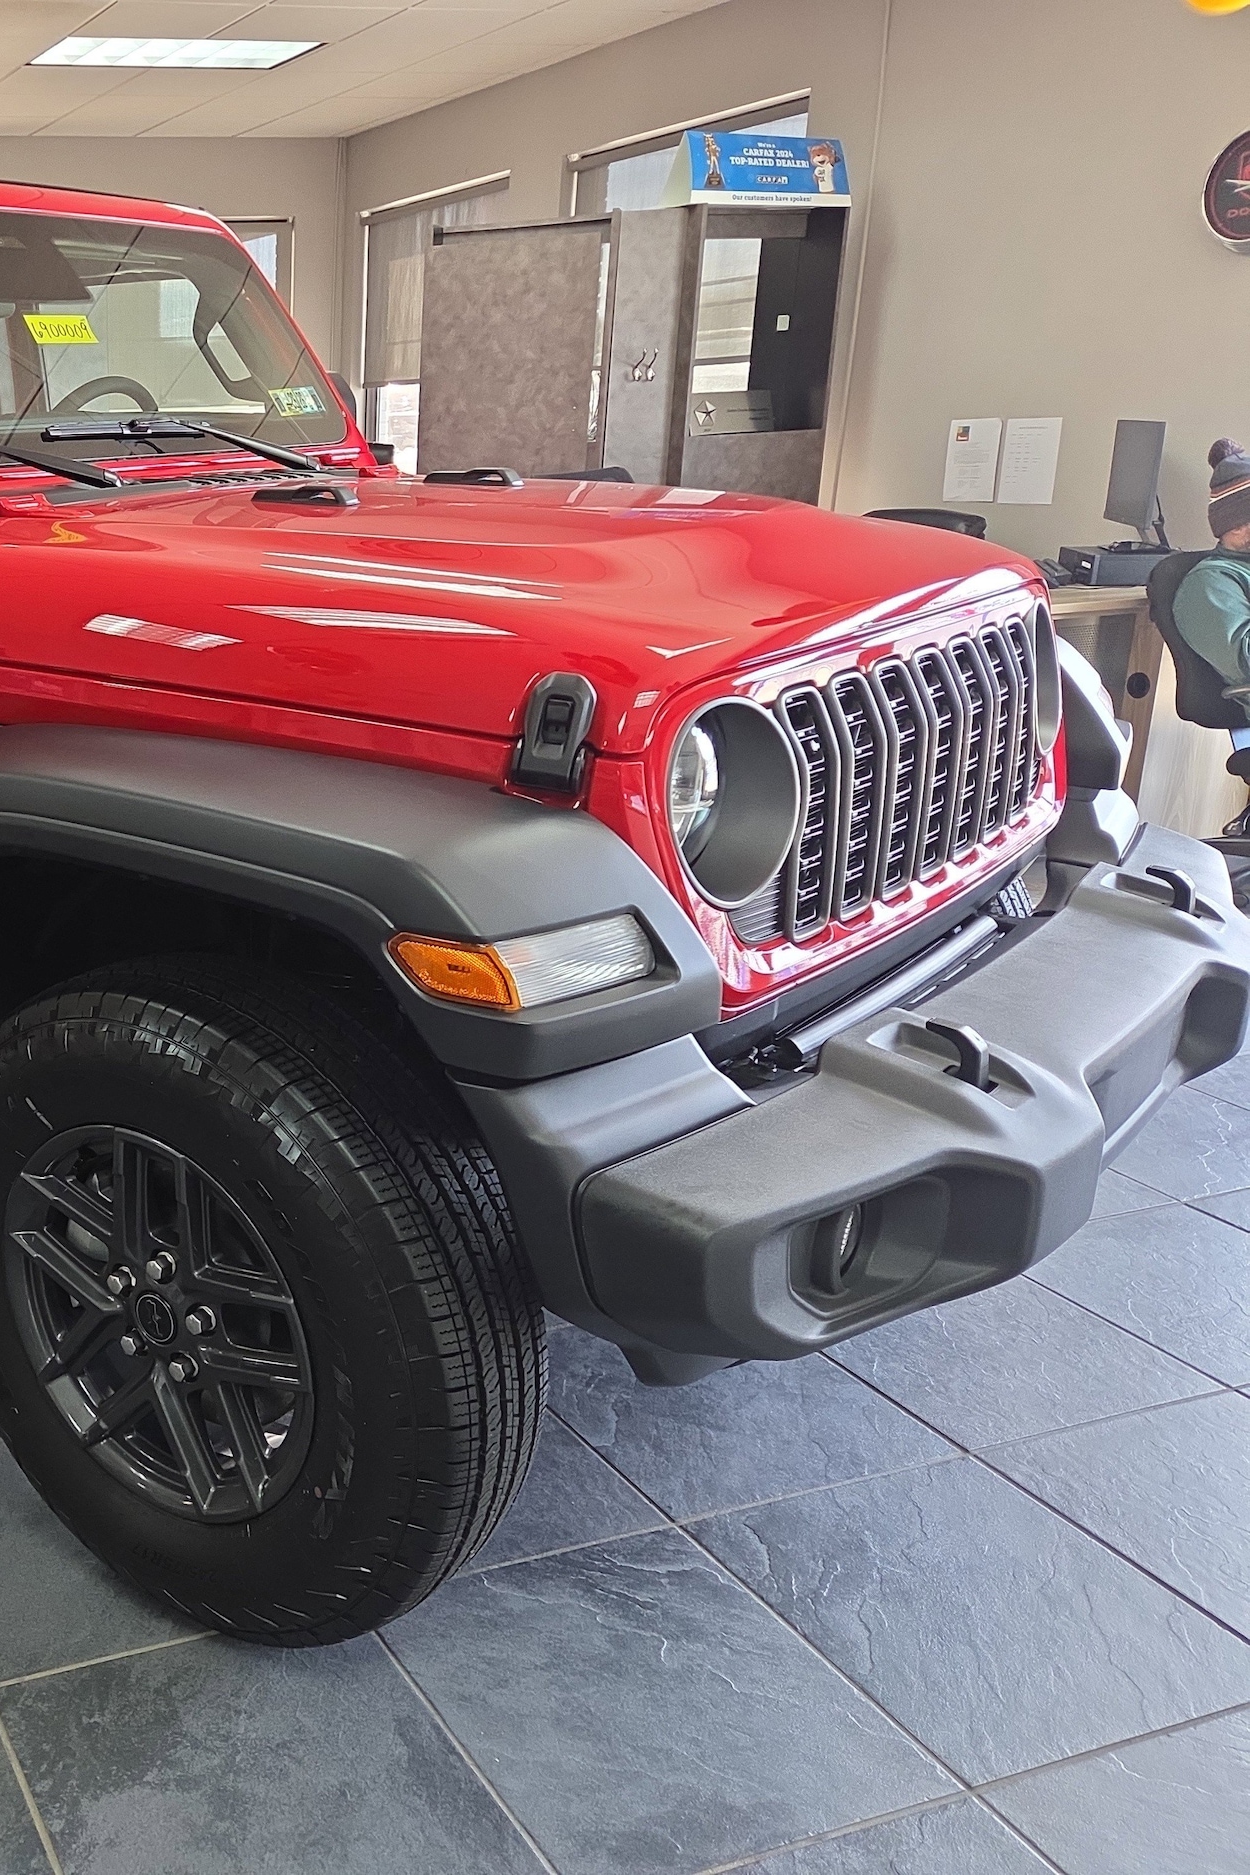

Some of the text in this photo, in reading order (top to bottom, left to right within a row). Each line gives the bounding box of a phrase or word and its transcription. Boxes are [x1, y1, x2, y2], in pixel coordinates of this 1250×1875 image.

[743, 148, 793, 158] CARFAX 2024
[730, 157, 810, 168] TOP-RATED DEALER!
[31, 321, 92, 339] 6900009
